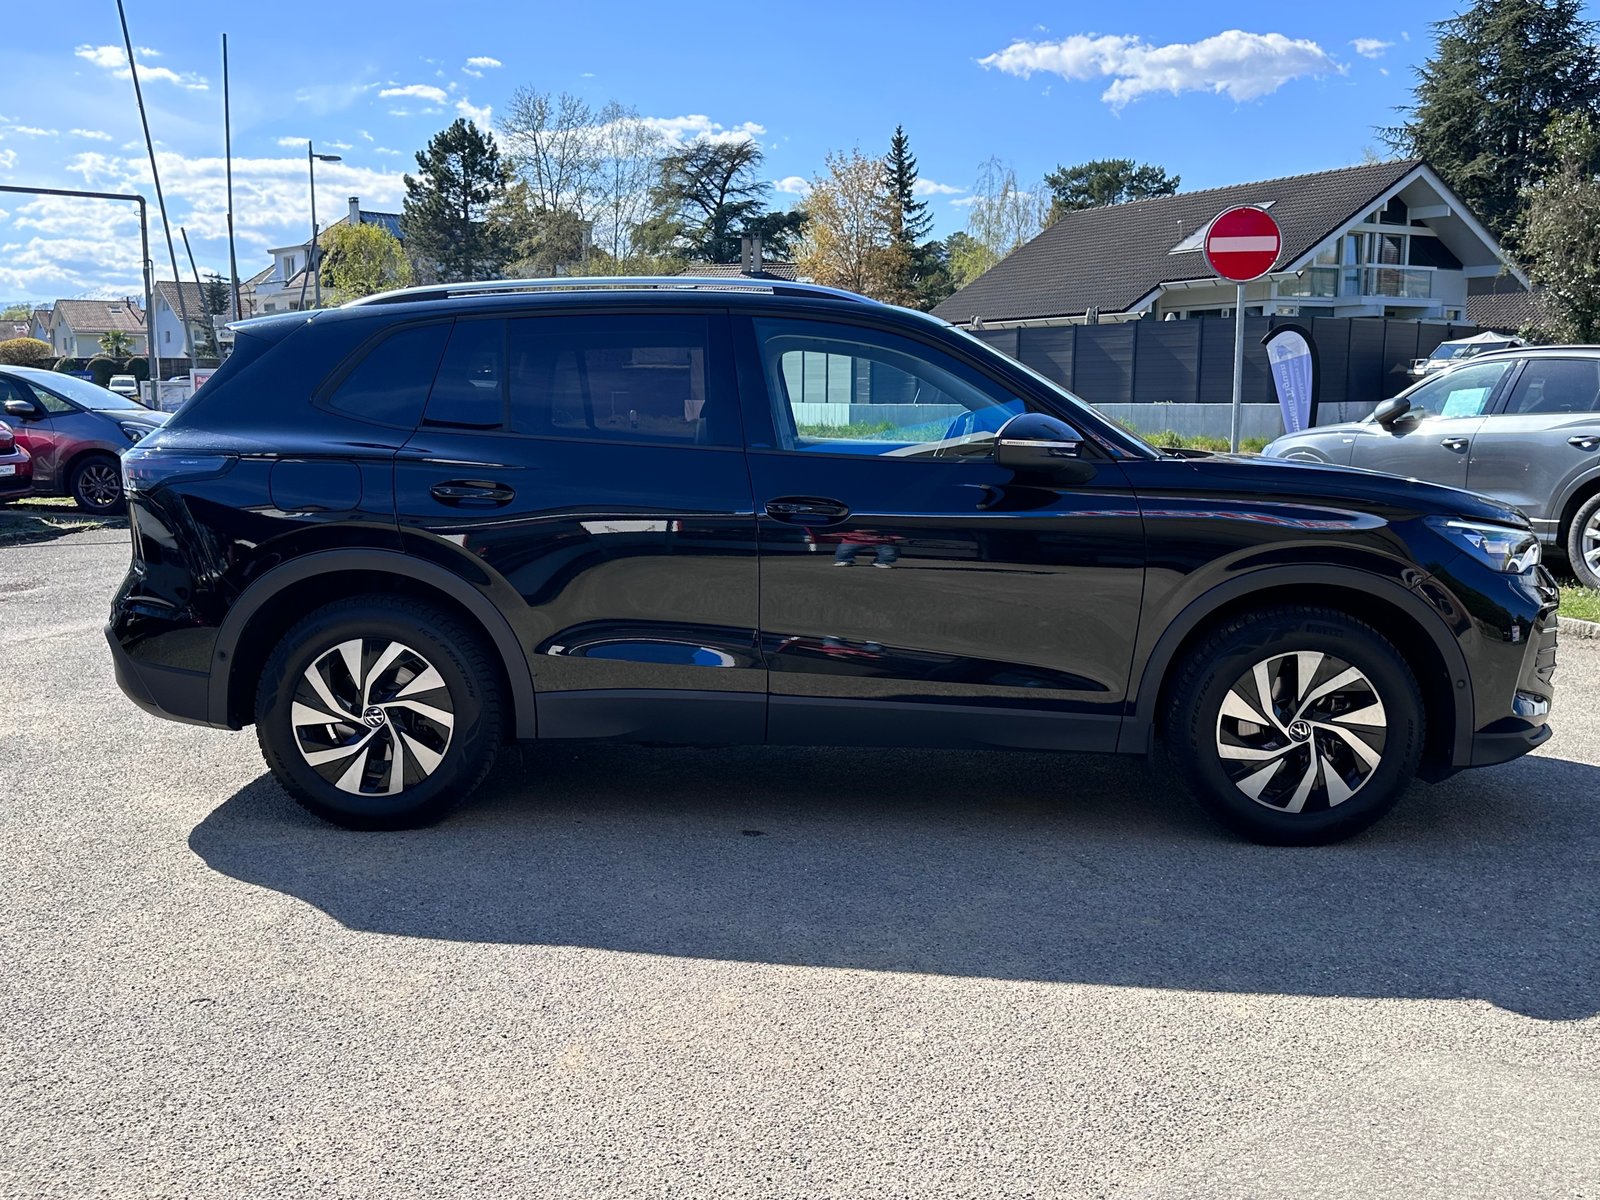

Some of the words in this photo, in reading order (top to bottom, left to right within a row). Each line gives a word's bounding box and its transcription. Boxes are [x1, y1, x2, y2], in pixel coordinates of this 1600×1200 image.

[418, 627, 438, 641] ICE
[440, 644, 476, 697] FRICTION
[1191, 671, 1215, 734] FRICTION
